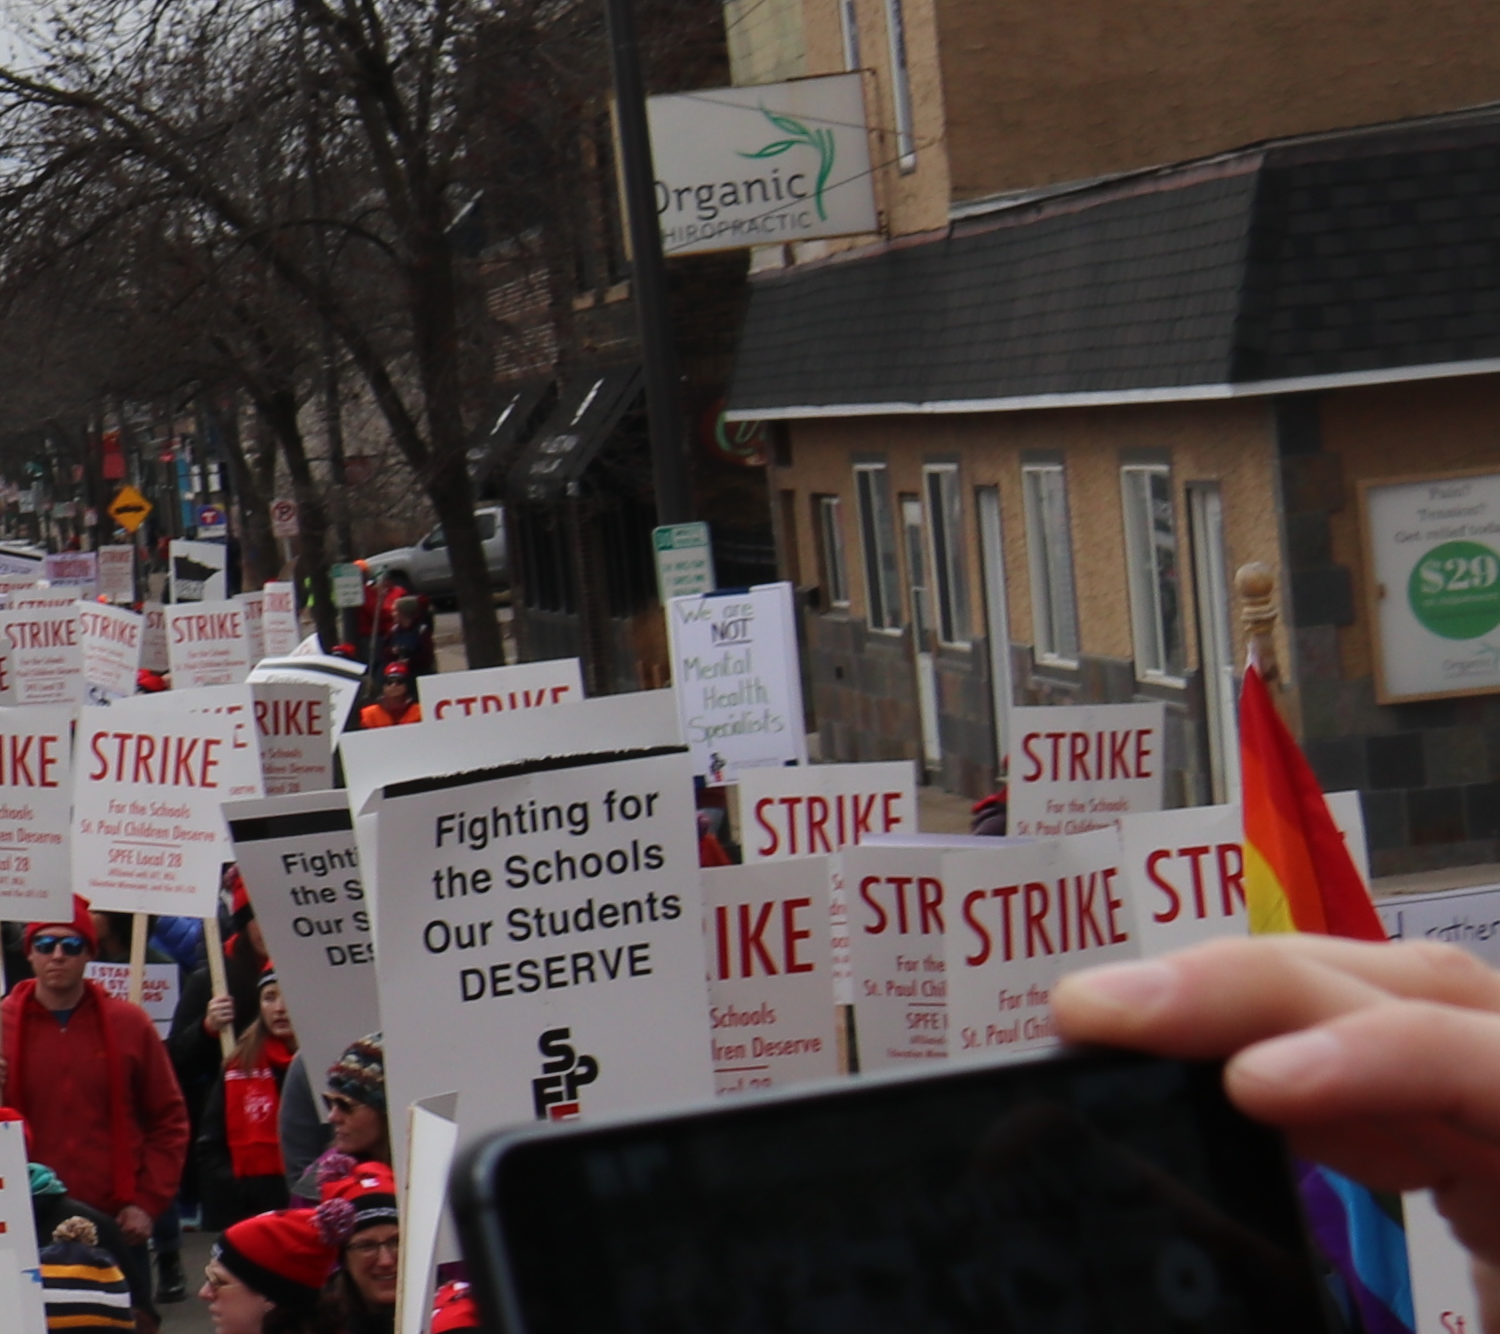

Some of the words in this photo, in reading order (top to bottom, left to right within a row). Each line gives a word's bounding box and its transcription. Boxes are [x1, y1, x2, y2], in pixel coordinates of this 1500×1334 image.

[664, 212, 811, 243] HIROPRACTIC
[1419, 556, 1499, 594] $29
[172, 612, 242, 643] STRIKE
[677, 599, 711, 624] We
[723, 604, 753, 617] are
[711, 618, 753, 642] NOT
[683, 650, 753, 682] Mental
[703, 678, 768, 710] Health
[689, 711, 785, 746] Specialists
[90, 732, 221, 788] STRIKE
[1023, 729, 1152, 782] STRIKE
[436, 801, 589, 850] Fighting
[604, 790, 658, 822] for
[432, 866, 491, 900] the
[505, 840, 664, 888] Schools
[424, 920, 492, 953] Our
[507, 892, 681, 941] Students
[962, 868, 1127, 966] STRIKE
[460, 943, 652, 1001] DESERVE
